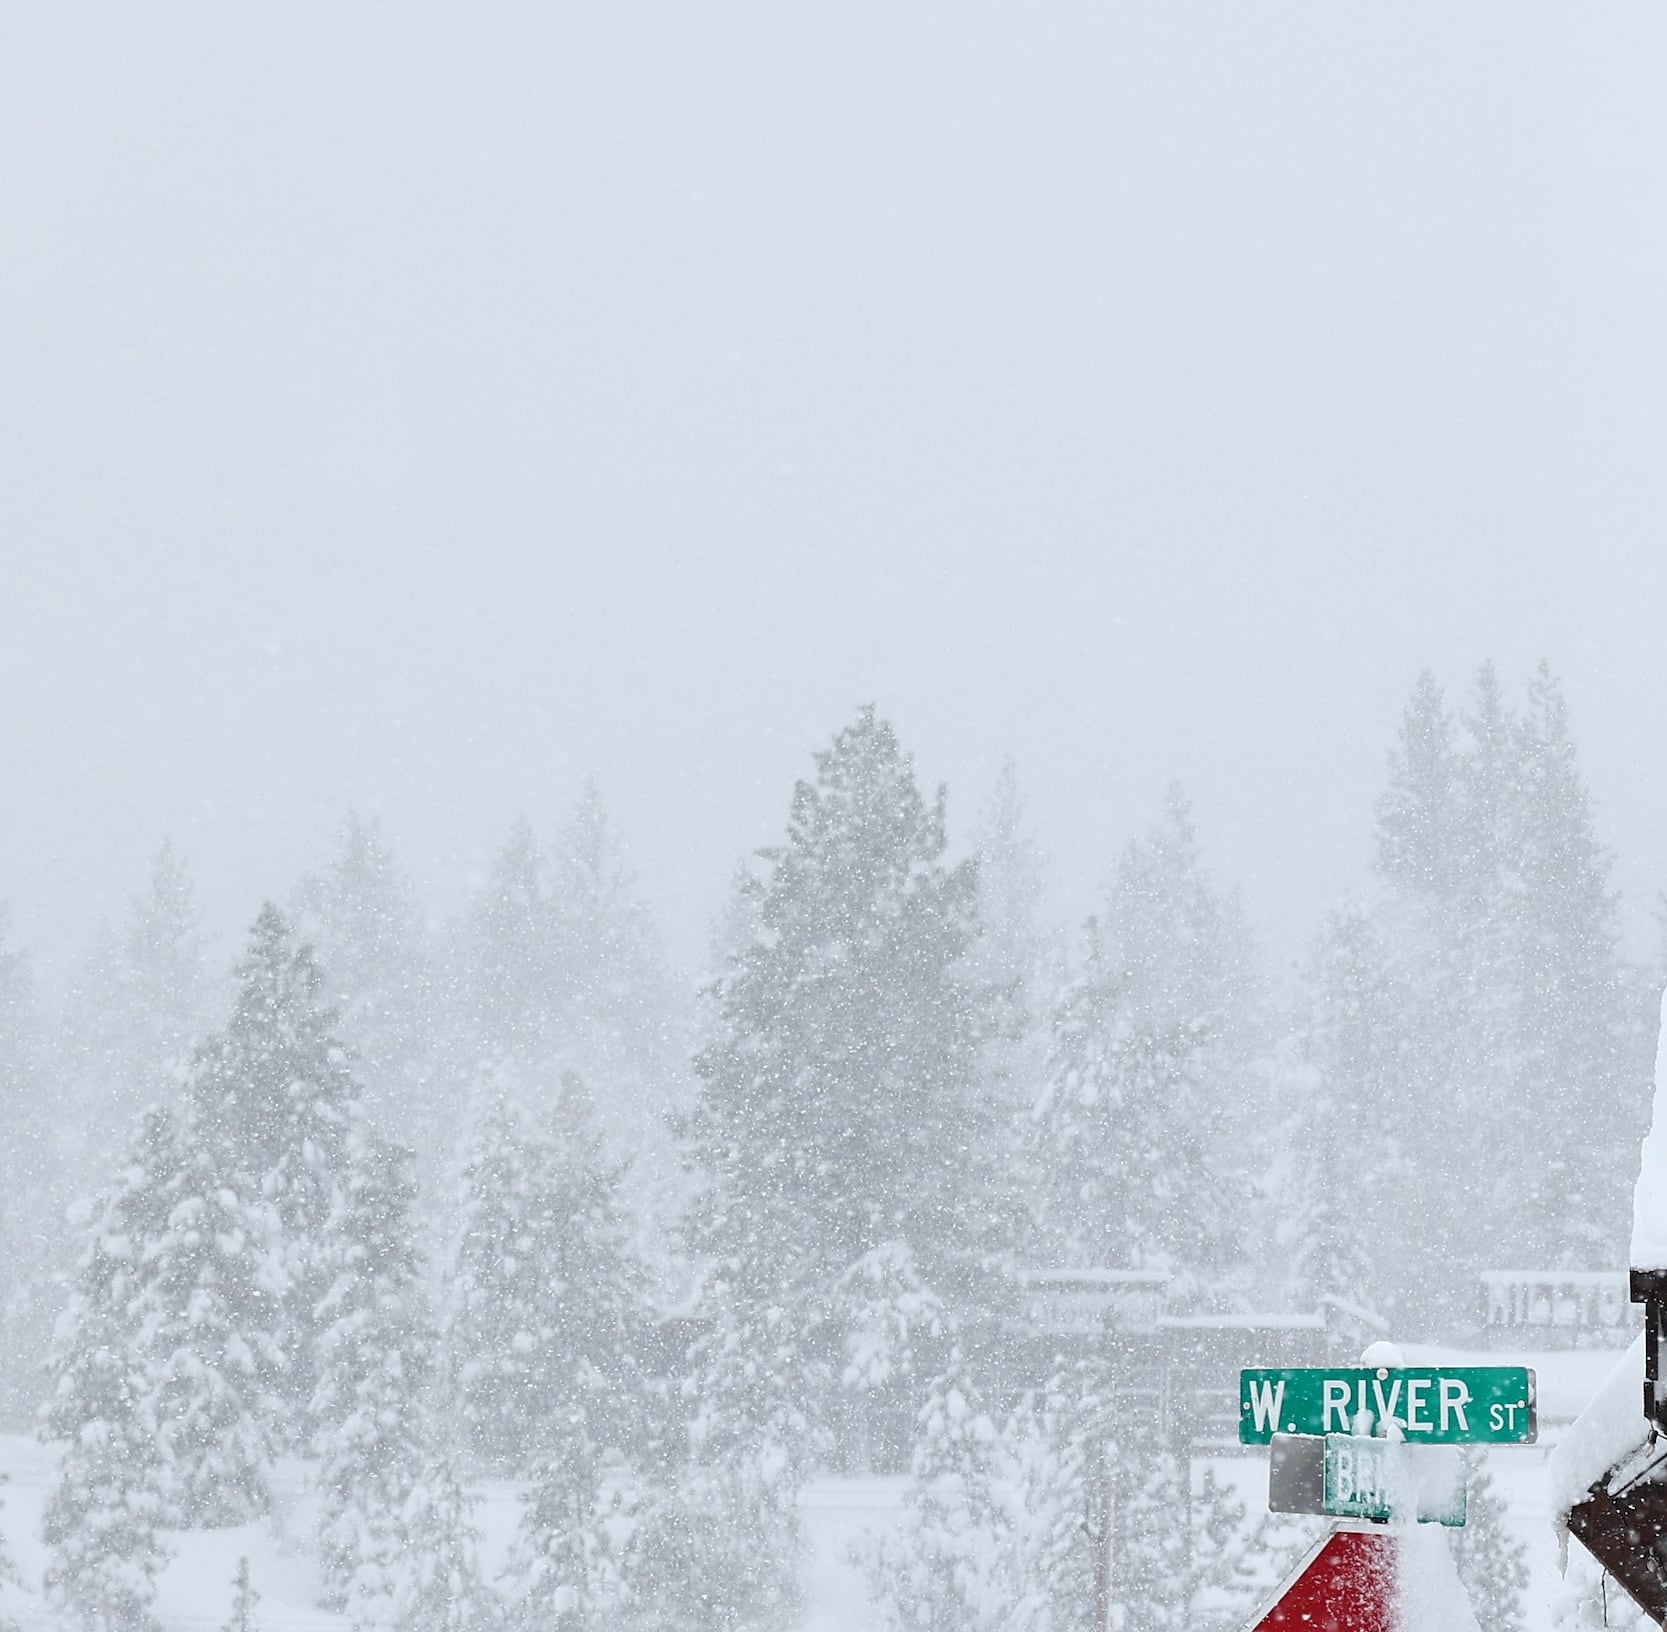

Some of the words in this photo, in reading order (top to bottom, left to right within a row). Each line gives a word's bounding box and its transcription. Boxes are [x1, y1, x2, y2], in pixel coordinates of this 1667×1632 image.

[1250, 1379, 1297, 1432] W.
[1322, 1379, 1470, 1431] RIVER
[1489, 1402, 1517, 1431] ST
